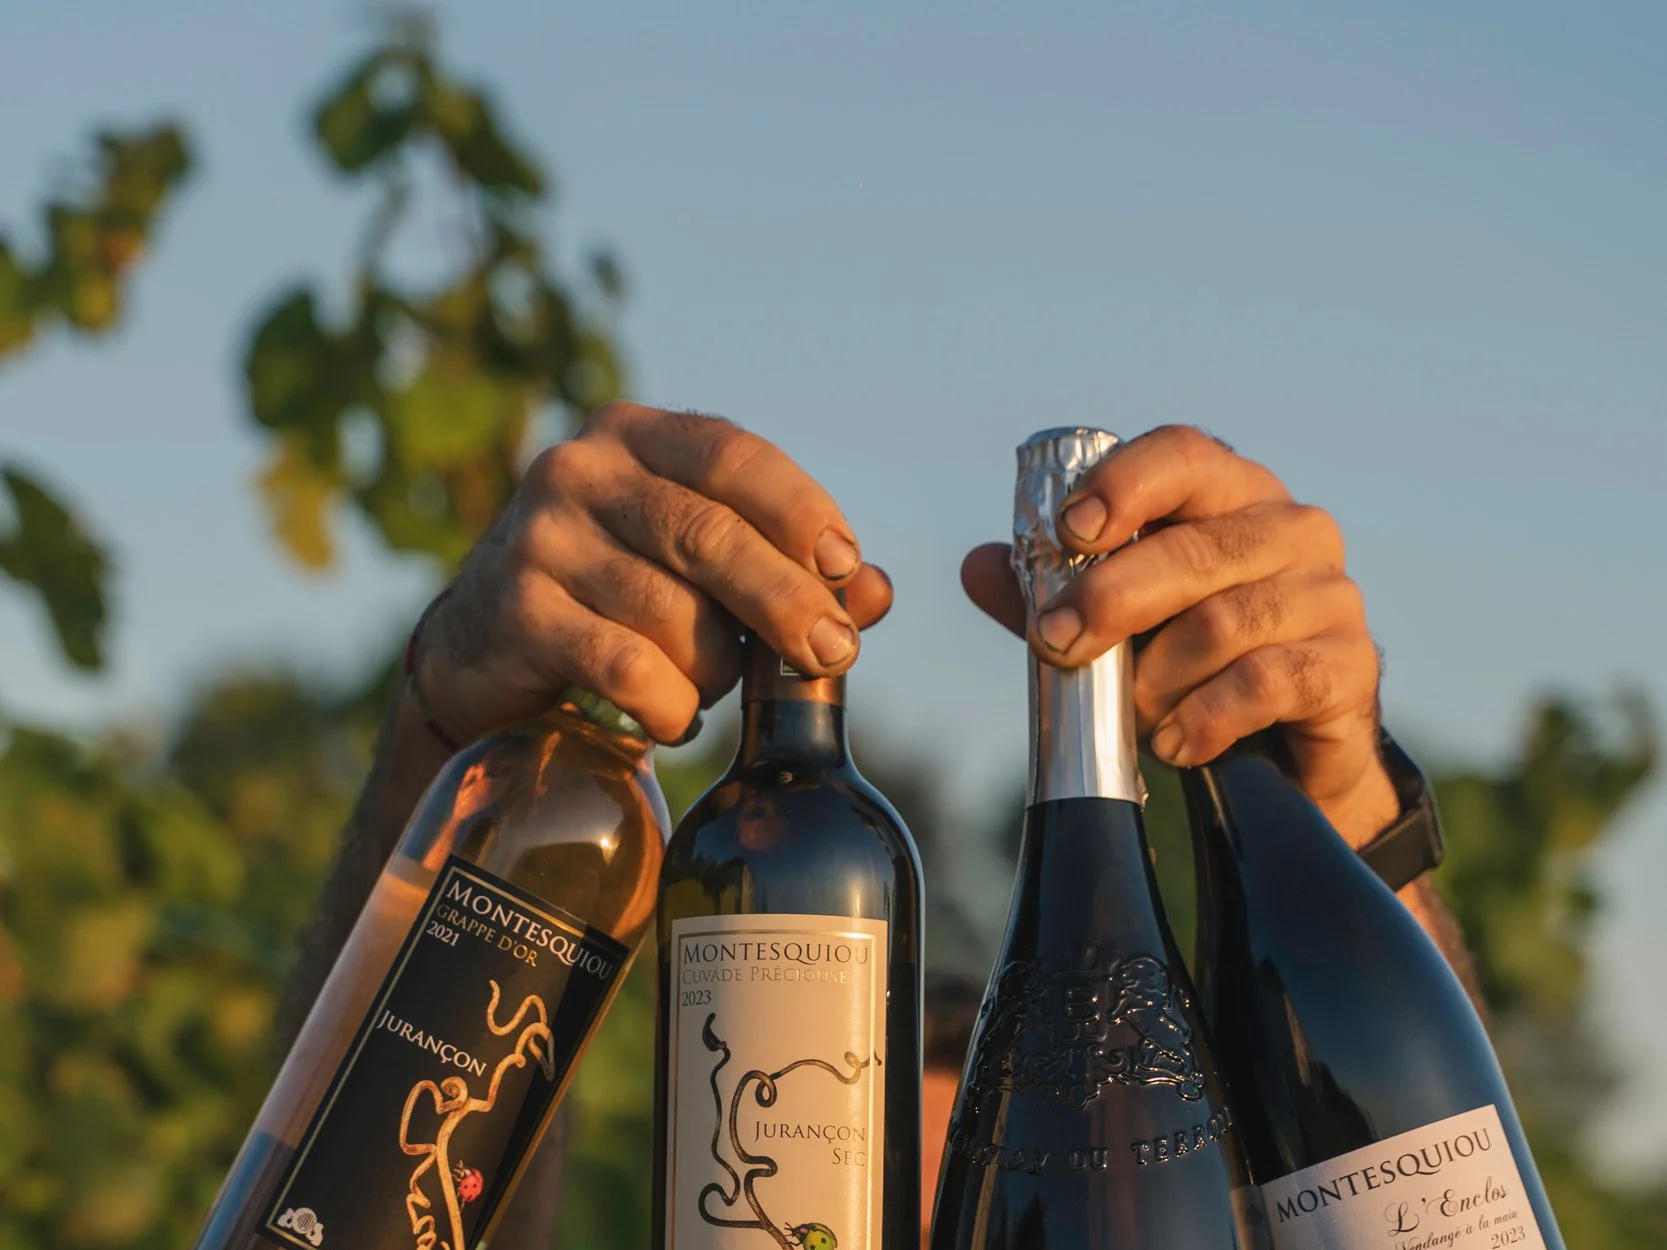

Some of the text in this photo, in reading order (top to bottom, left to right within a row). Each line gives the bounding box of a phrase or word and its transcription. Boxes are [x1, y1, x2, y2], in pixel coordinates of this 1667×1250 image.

[427, 921, 460, 947] 2021
[436, 904, 538, 967] GRAPPE D'OR
[447, 880, 613, 979] MONTESQUIOU
[683, 943, 869, 965] MONTESQUIOU
[682, 965, 848, 985] CUVADE PRÉCIOUSE
[682, 989, 712, 1007] 2023
[376, 1010, 487, 1078] JURANÇON
[754, 1120, 866, 1145] JURANÇON
[831, 1148, 867, 1168] SEC
[1276, 1128, 1492, 1223] MONTESQUIOU
[1465, 1223, 1474, 1235] à
[1478, 1214, 1490, 1230] la
[1494, 1209, 1518, 1225] main
[1490, 1225, 1526, 1250] 2023
